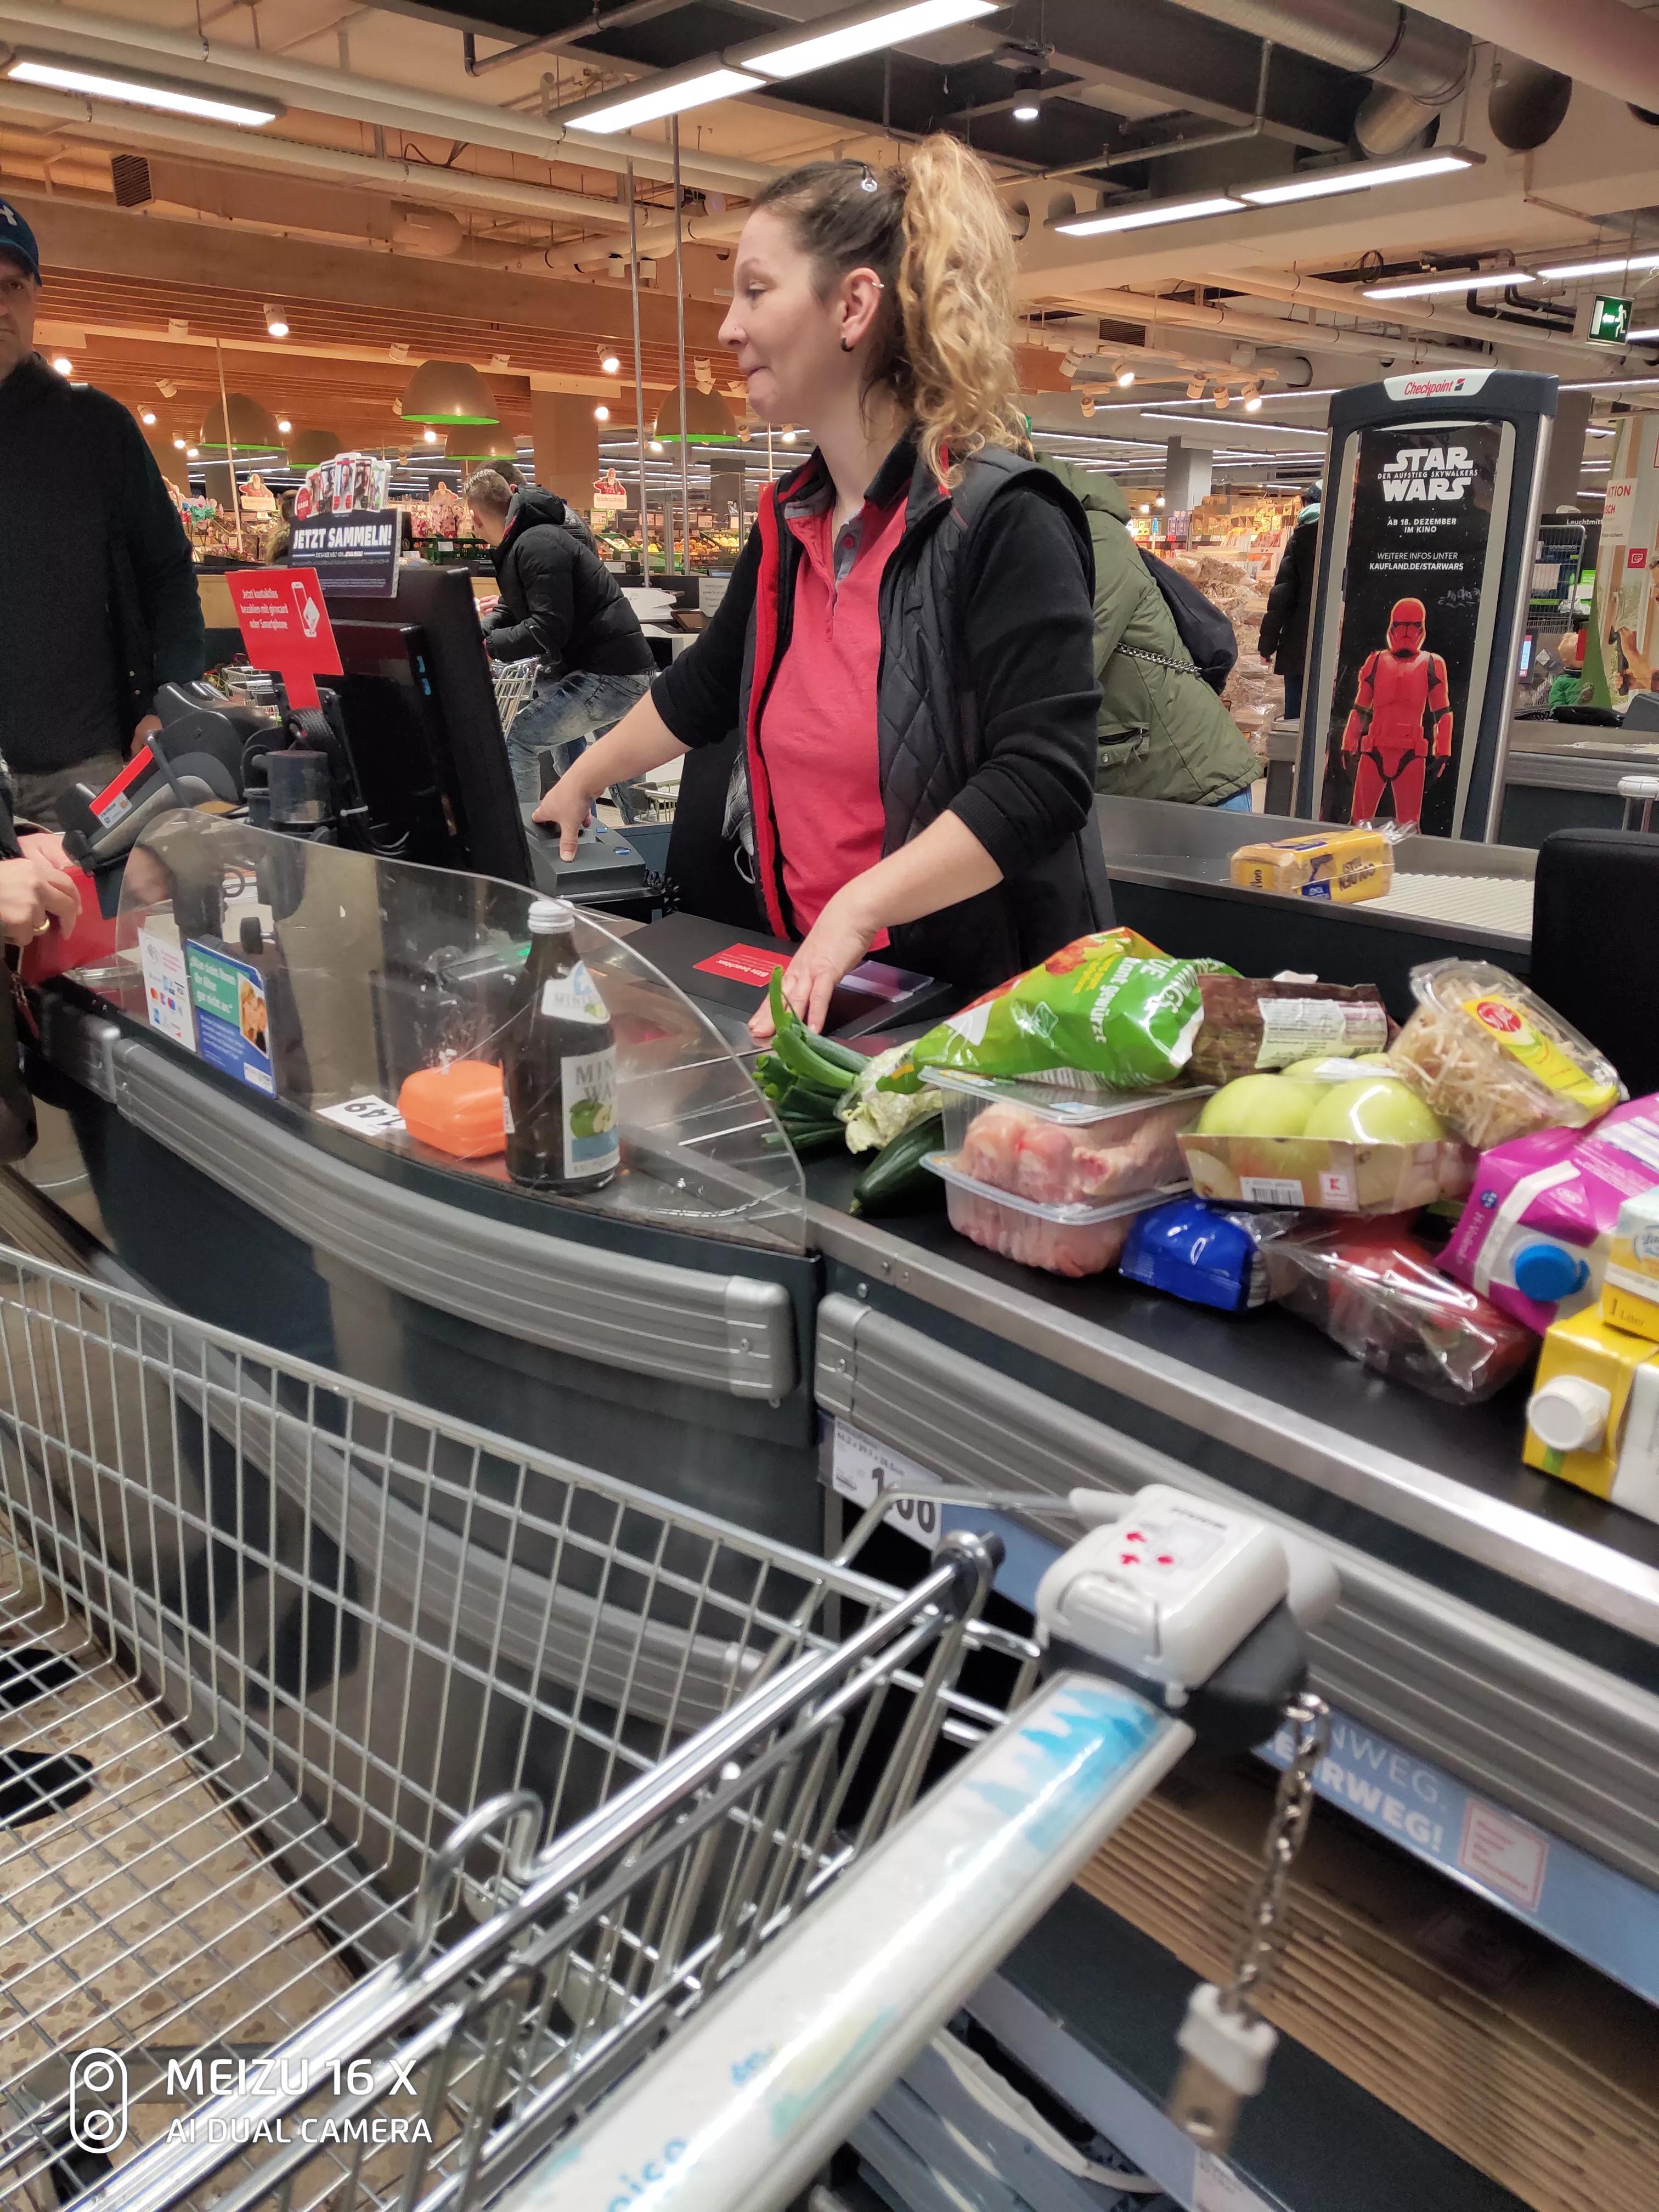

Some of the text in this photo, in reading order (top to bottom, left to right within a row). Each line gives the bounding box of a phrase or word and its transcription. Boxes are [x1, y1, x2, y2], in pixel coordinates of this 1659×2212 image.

[1404, 379, 1453, 396] Checkpoint
[1384, 447, 1474, 472] STAR
[1383, 477, 1471, 501] WARS
[293, 524, 392, 549] JETZT SAMMELN!
[1369, 563, 1464, 571] KAUFLAND.DE/STARWARS
[259, 618, 289, 631] Smartphone
[1323, 1723, 1447, 1809] NWEG.
